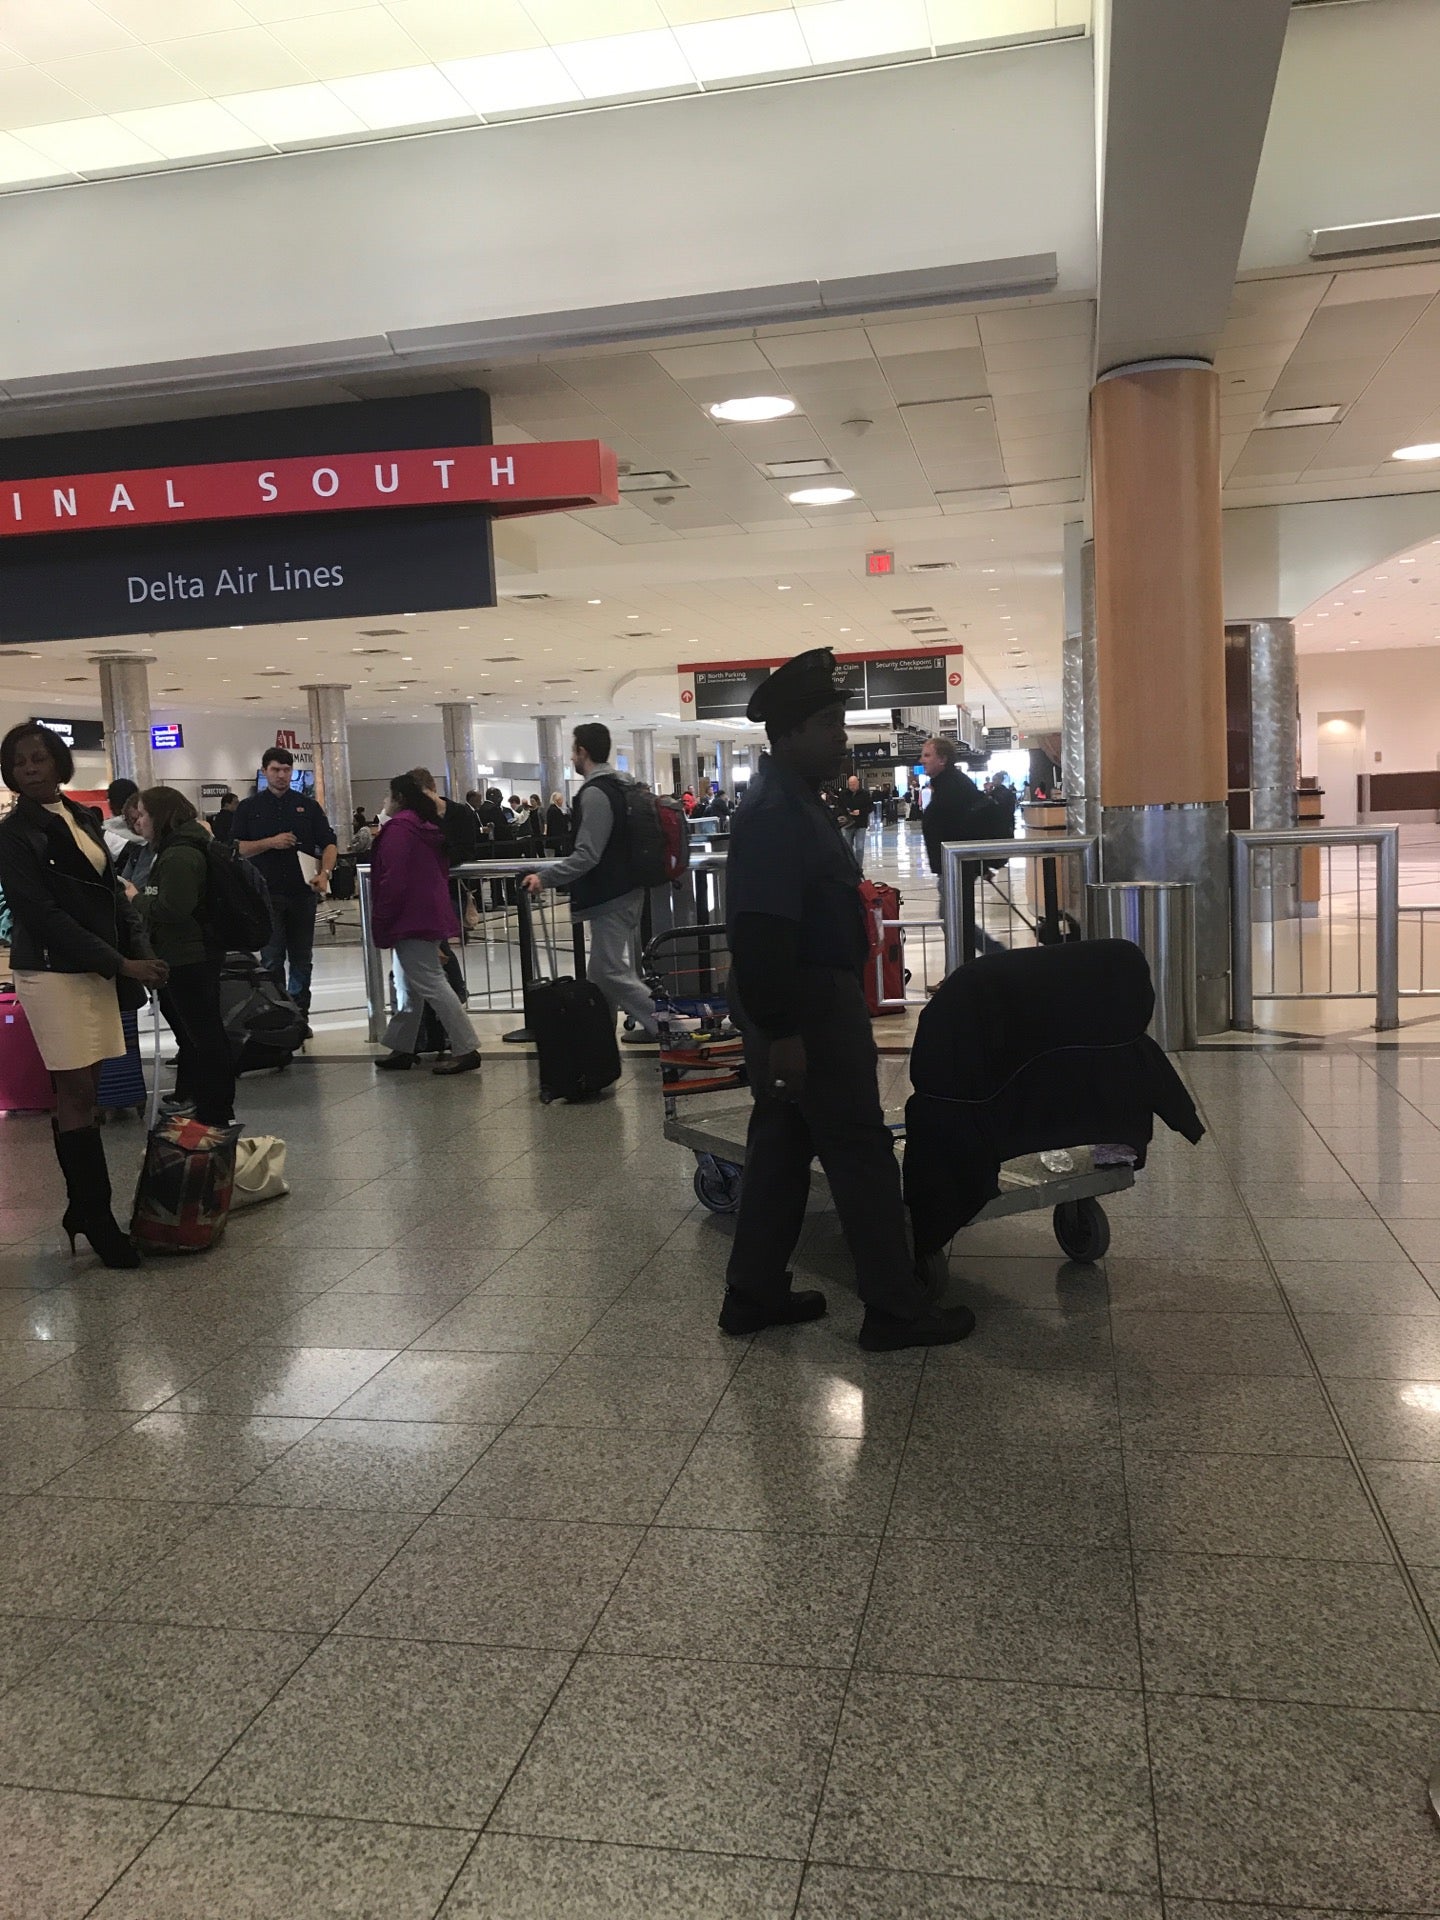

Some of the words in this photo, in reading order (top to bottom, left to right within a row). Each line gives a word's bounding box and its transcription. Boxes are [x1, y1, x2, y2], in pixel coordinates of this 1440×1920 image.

[258, 456, 515, 502] SOUTH
[127, 572, 205, 604] Delta
[215, 566, 258, 597] Air
[268, 562, 344, 592] Lines
[725, 670, 746, 678] Parking
[875, 661, 898, 669] Security
[899, 659, 932, 667] Checkpoint
